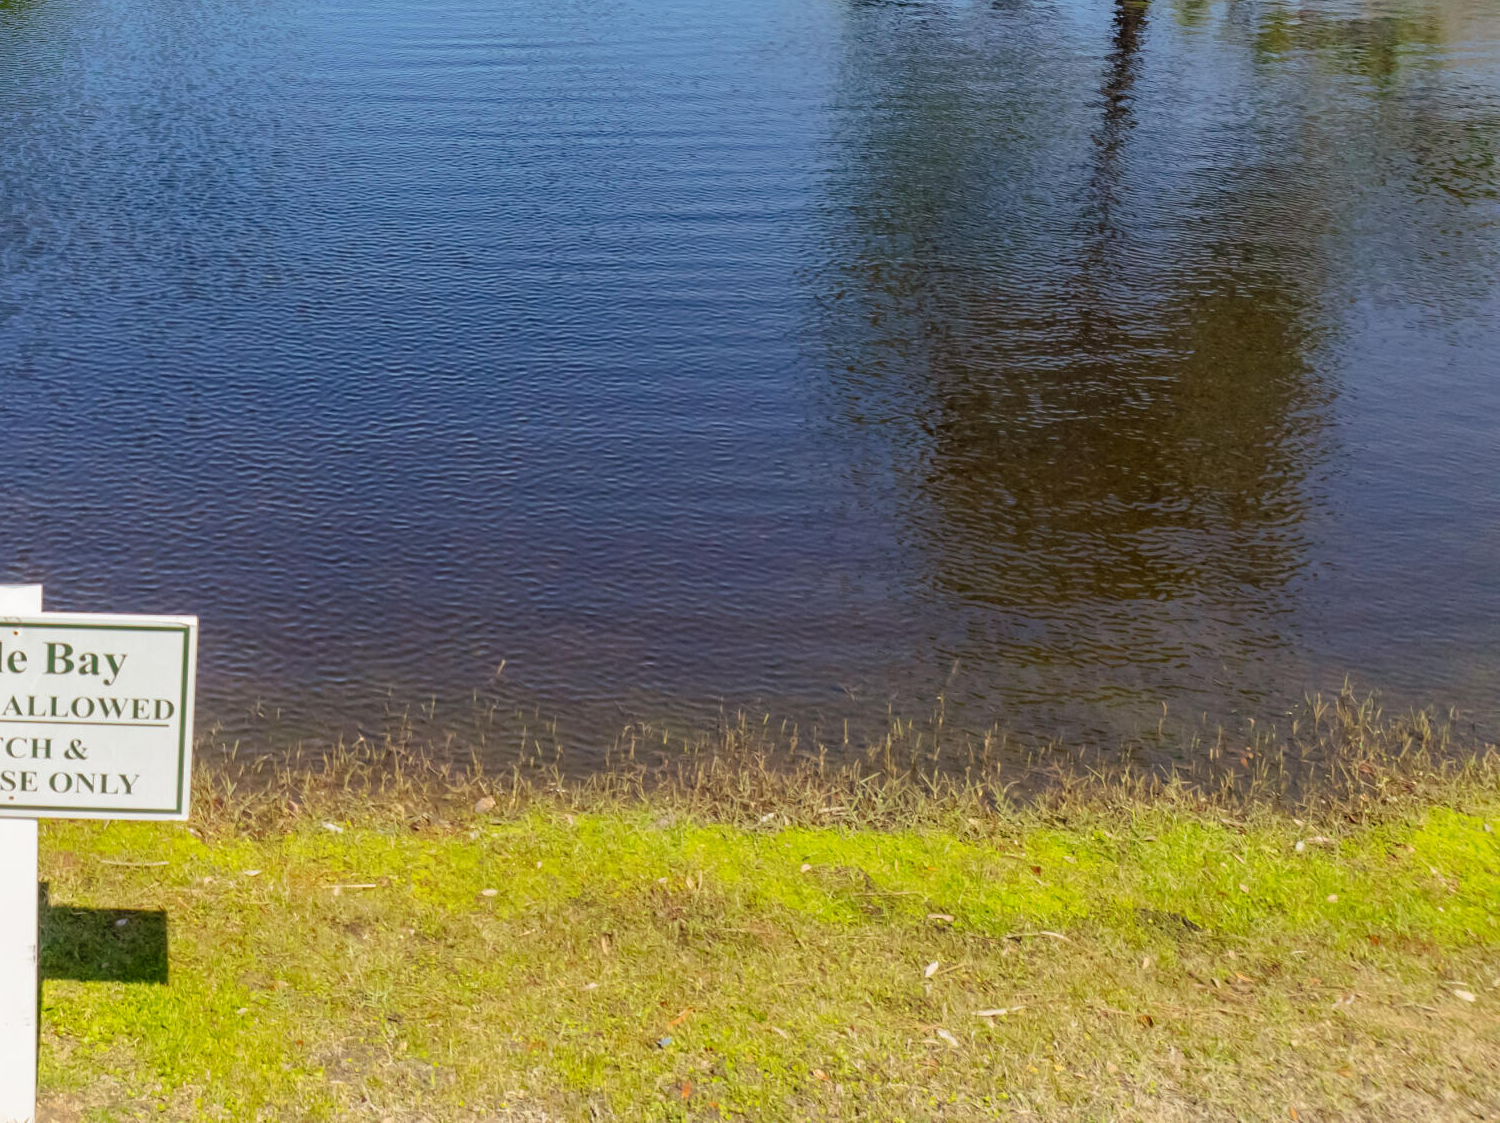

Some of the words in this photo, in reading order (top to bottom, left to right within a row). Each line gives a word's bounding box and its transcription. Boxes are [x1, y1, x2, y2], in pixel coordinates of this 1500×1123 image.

[43, 641, 127, 686] Bay
[3, 694, 175, 721] ALLOWED
[63, 738, 88, 761] &
[48, 771, 140, 795] ONLY
